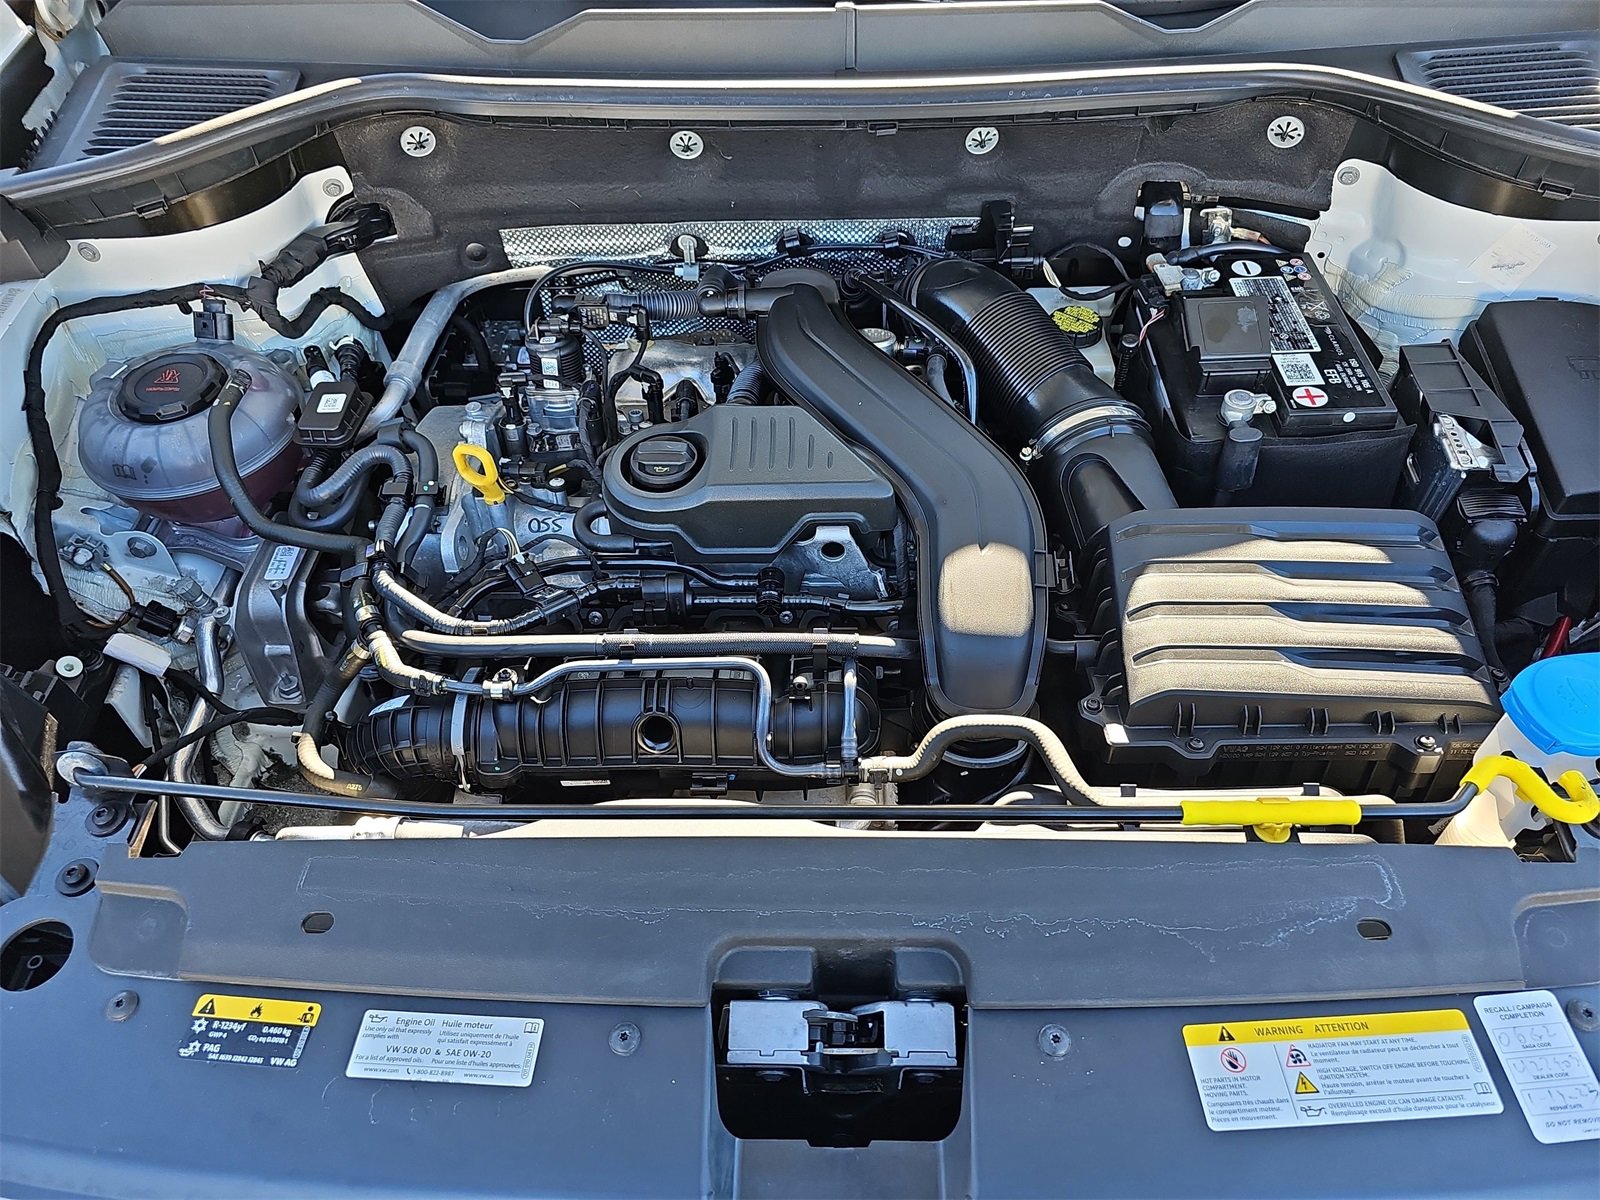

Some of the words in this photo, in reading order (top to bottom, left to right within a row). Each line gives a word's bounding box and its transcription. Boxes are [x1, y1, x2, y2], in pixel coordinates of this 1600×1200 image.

[1328, 334, 1344, 355] CLARIOS
[1324, 369, 1342, 384] EFB
[1484, 1005, 1511, 1014] RECALL
[1517, 1002, 1553, 1010] CAMPAIGN
[1500, 1011, 1545, 1020] COMPLETION
[396, 1017, 422, 1027] Engine
[212, 1021, 247, 1033] R-1234yf
[262, 1026, 282, 1034] 0.460
[283, 1027, 292, 1037] kg
[1254, 1025, 1303, 1036] WARNING
[1314, 1022, 1369, 1032] ATTENTION
[202, 1043, 221, 1052] PAG
[463, 1050, 491, 1058] 0W-20
[284, 1058, 297, 1067] AG
[1414, 1104, 1444, 1113] dangereux
